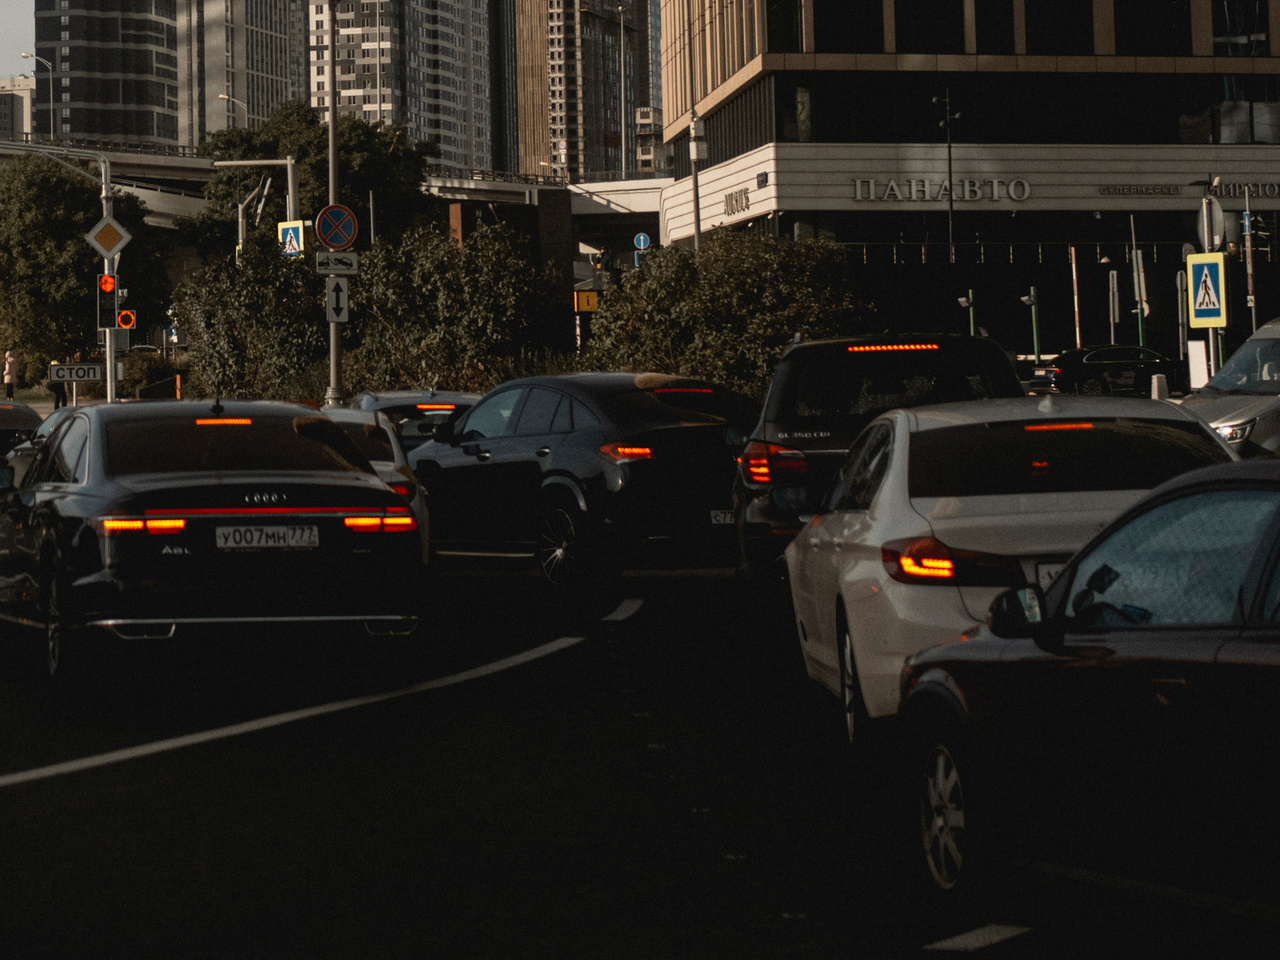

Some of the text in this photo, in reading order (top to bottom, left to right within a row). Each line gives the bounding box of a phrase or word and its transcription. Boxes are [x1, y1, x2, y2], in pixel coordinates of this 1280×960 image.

[852, 179, 1031, 201] ПАНАВТО
[1099, 185, 1182, 195] СУПЕРМАРКЕТ
[56, 367, 97, 379] СТОП
